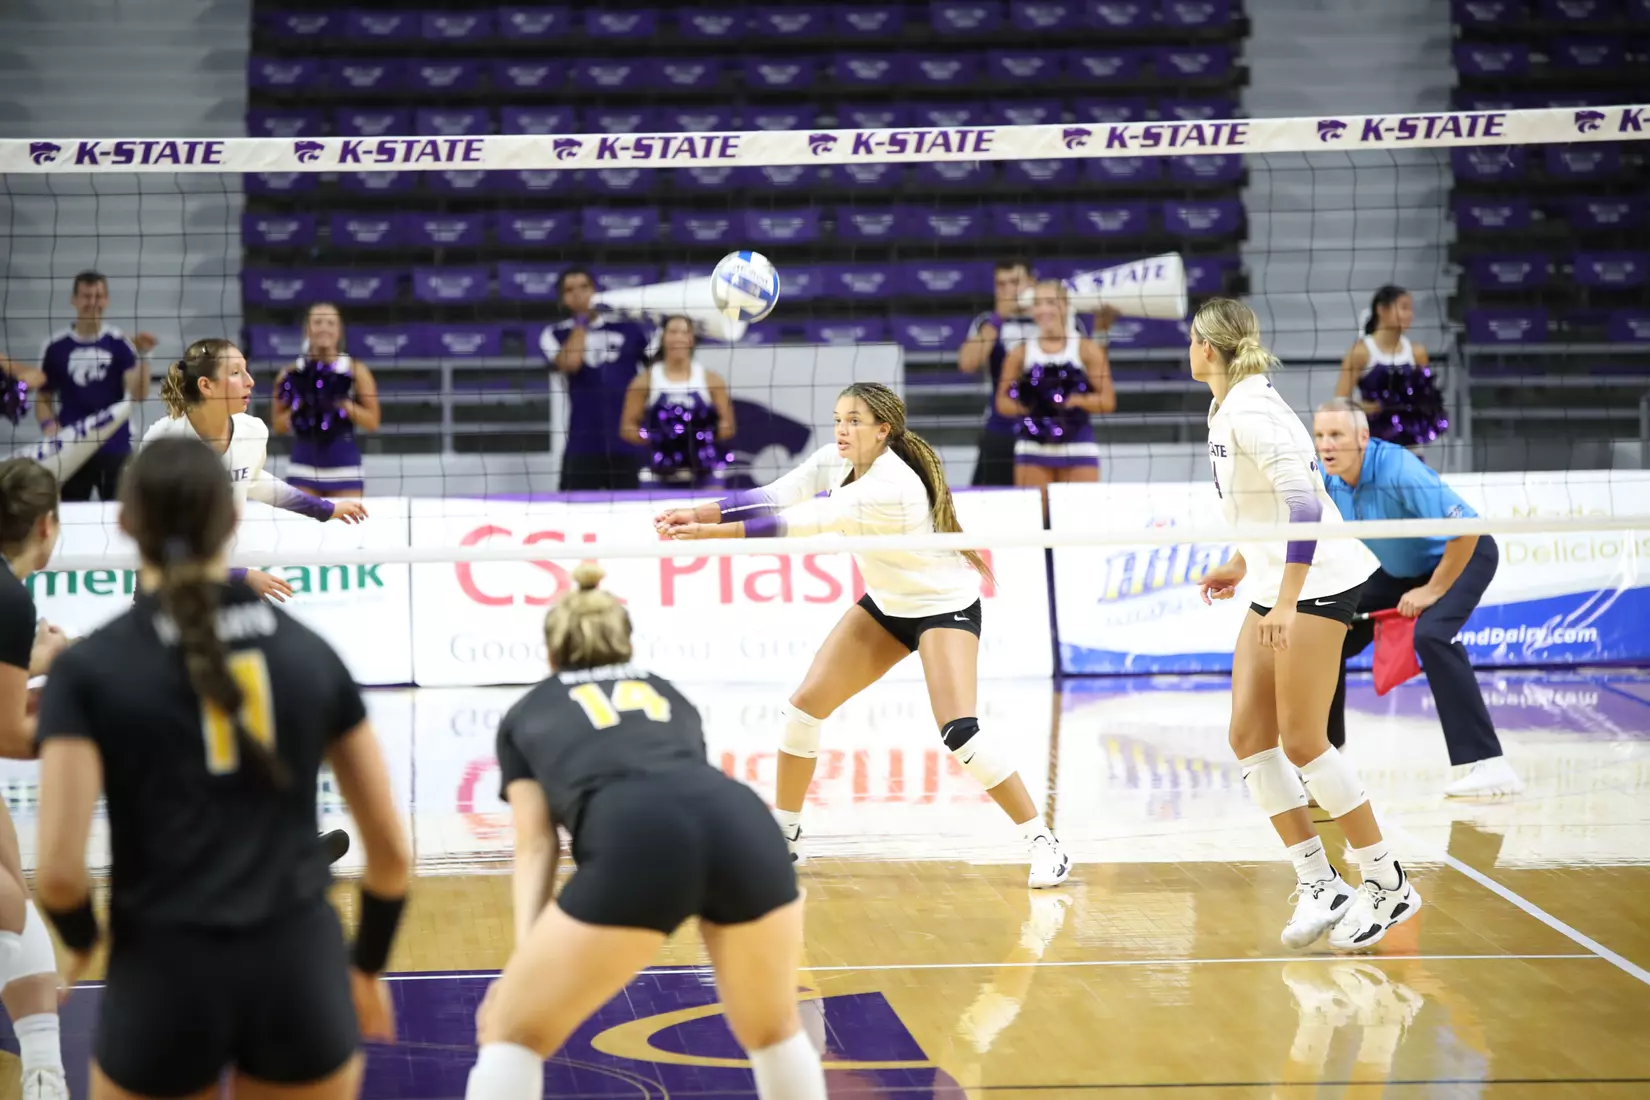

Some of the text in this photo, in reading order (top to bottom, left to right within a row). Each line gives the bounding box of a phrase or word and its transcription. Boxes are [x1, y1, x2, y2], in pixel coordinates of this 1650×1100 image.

[1361, 113, 1506, 141] K-STATE
[1618, 108, 1650, 132] K-
[597, 136, 741, 160] K-STATE
[852, 130, 996, 155] K-STATE
[1106, 123, 1249, 149] K-STATE
[74, 141, 226, 165] K-STATE
[339, 139, 486, 163] K-STATE
[259, 563, 384, 594] ank
[568, 679, 671, 730] 14
